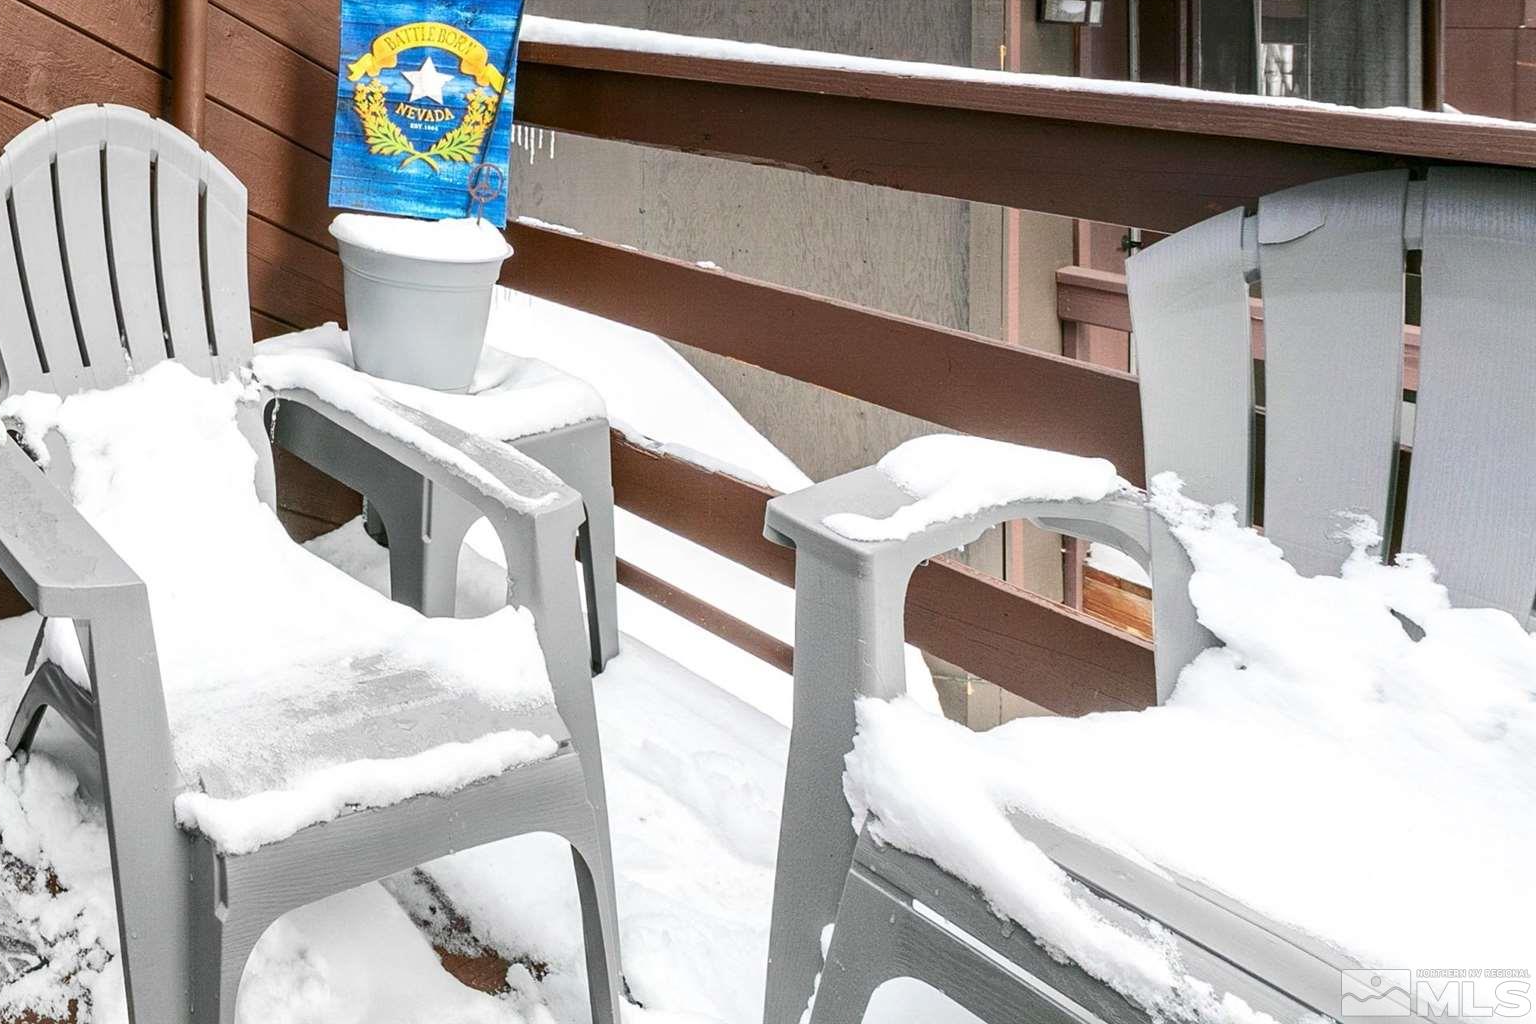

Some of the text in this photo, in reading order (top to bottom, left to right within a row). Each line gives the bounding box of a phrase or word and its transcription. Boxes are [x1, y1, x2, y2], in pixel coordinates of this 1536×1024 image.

[383, 26, 477, 55] BATTLE BORN
[395, 102, 455, 122] NEVADA
